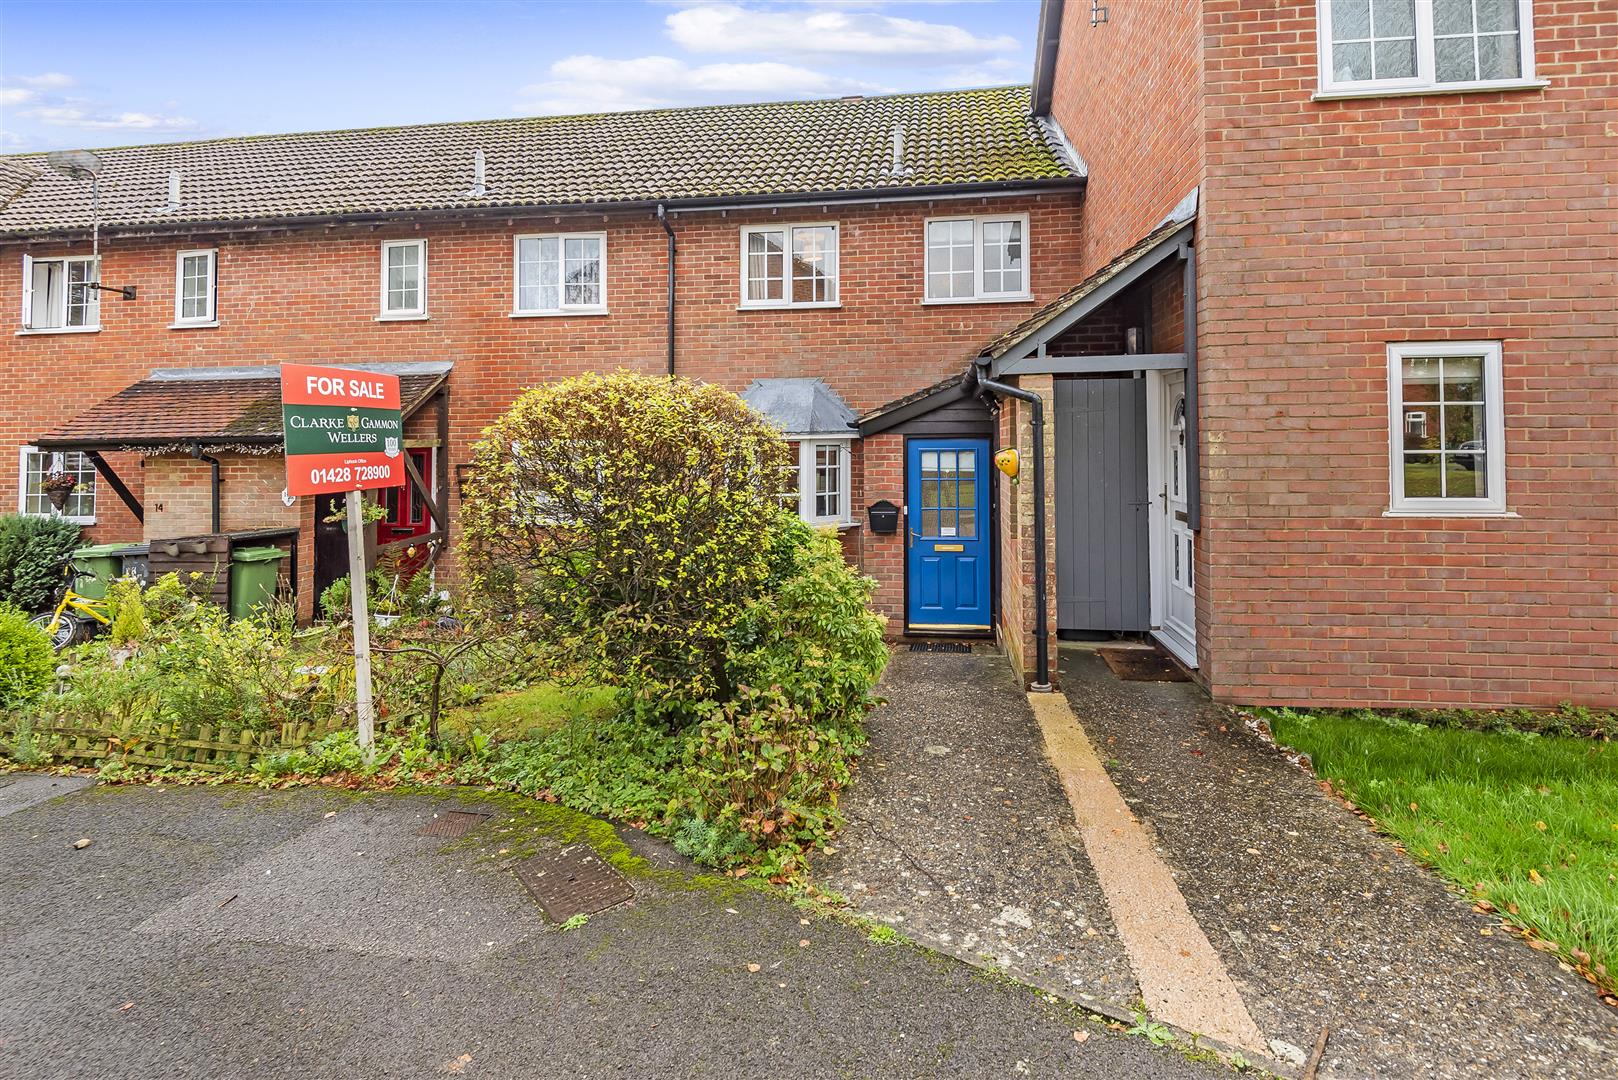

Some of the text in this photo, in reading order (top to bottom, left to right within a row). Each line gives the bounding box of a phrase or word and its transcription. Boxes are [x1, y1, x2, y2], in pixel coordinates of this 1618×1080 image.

[306, 376, 384, 399] FOR SALE
[290, 415, 398, 429] CLARKE GAMMON
[327, 431, 377, 443] WELLERS
[311, 465, 390, 484] 01428 728900
[155, 503, 163, 512] 14
